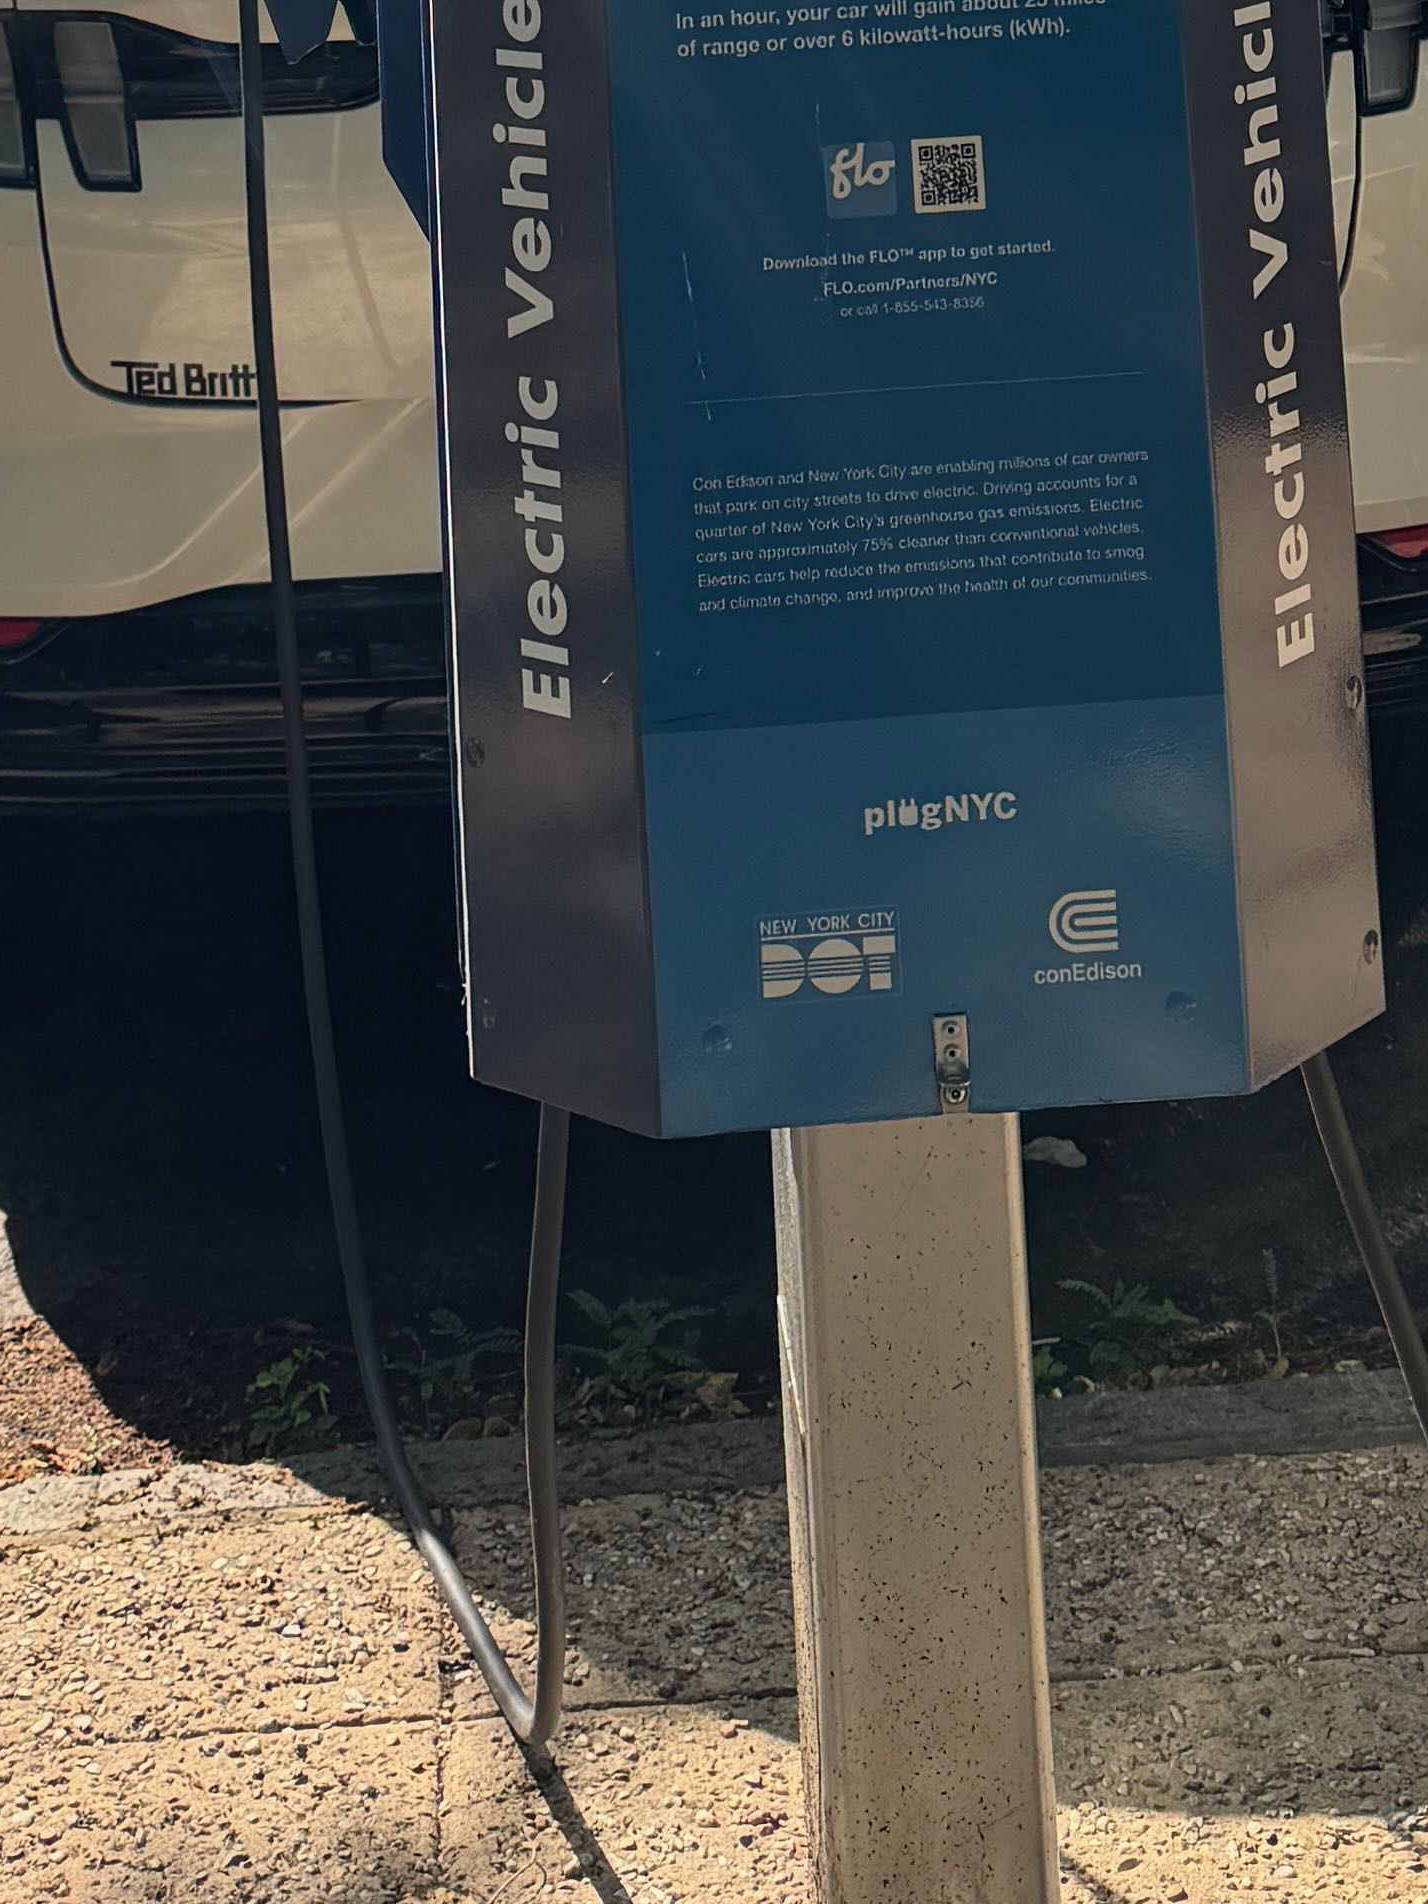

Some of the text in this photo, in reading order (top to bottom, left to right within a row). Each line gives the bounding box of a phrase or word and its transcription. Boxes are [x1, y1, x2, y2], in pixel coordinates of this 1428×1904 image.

[677, 13, 693, 29] In
[701, 15, 724, 27] an
[731, 9, 780, 25] hour,
[787, 8, 830, 25] your
[837, 6, 868, 18] car
[875, 0, 906, 16] will
[678, 17, 1070, 57] of range or over 6 kilowatt-hours (kWh).
[830, 143, 895, 198] flo
[764, 254, 837, 270] Download
[842, 253, 864, 265] the
[919, 249, 946, 262] app
[951, 247, 965, 257] to
[970, 245, 993, 259] get
[998, 240, 1055, 255] started.
[824, 272, 997, 297] FLO.com/Partners/NYC
[841, 308, 852, 317] or
[857, 304, 878, 315] call
[110, 360, 258, 397] Ted Britt
[693, 451, 1148, 491] Con Edison and New York City are enabling millions of car owners
[695, 502, 720, 514] that
[727, 500, 756, 515] park
[762, 500, 779, 510] on
[784, 497, 809, 511] city
[814, 493, 861, 506] streets
[867, 491, 880, 502] to
[885, 490, 918, 501] drive
[924, 486, 978, 499] electric.
[984, 482, 1032, 495] Driving
[1037, 477, 1101, 491] accounts
[1106, 474, 1123, 487] for
[1255, 322, 1315, 668] Electric
[695, 526, 747, 541] quarter
[752, 522, 765, 535] of
[772, 521, 803, 533] New
[808, 518, 840, 530] York
[890, 511, 973, 528] greenhouse
[979, 509, 1004, 522] gas
[1009, 504, 1084, 517] emissions.
[1090, 498, 1143, 512] Electric
[504, 375, 571, 719] Electric
[697, 552, 727, 563] cars
[732, 550, 753, 560] are
[759, 541, 857, 560] approximately
[899, 536, 949, 549] cleaner
[955, 533, 985, 545] than
[990, 525, 1079, 542] conventional
[1084, 522, 1144, 536] vehicles.
[699, 547, 1144, 587] Electric cars help reduce the emissions that contribute to smog
[700, 598, 725, 611] and
[731, 596, 780, 609] climate
[847, 588, 872, 600] and
[878, 585, 933, 600] improve
[939, 583, 960, 594] the
[965, 579, 1007, 592] health
[1013, 576, 1025, 589] of
[1031, 577, 1053, 588] our
[1059, 570, 1151, 586] communities.
[760, 912, 894, 935] NEW YORK CITY
[762, 935, 895, 998] DOT
[1035, 962, 1141, 984] conEdison
